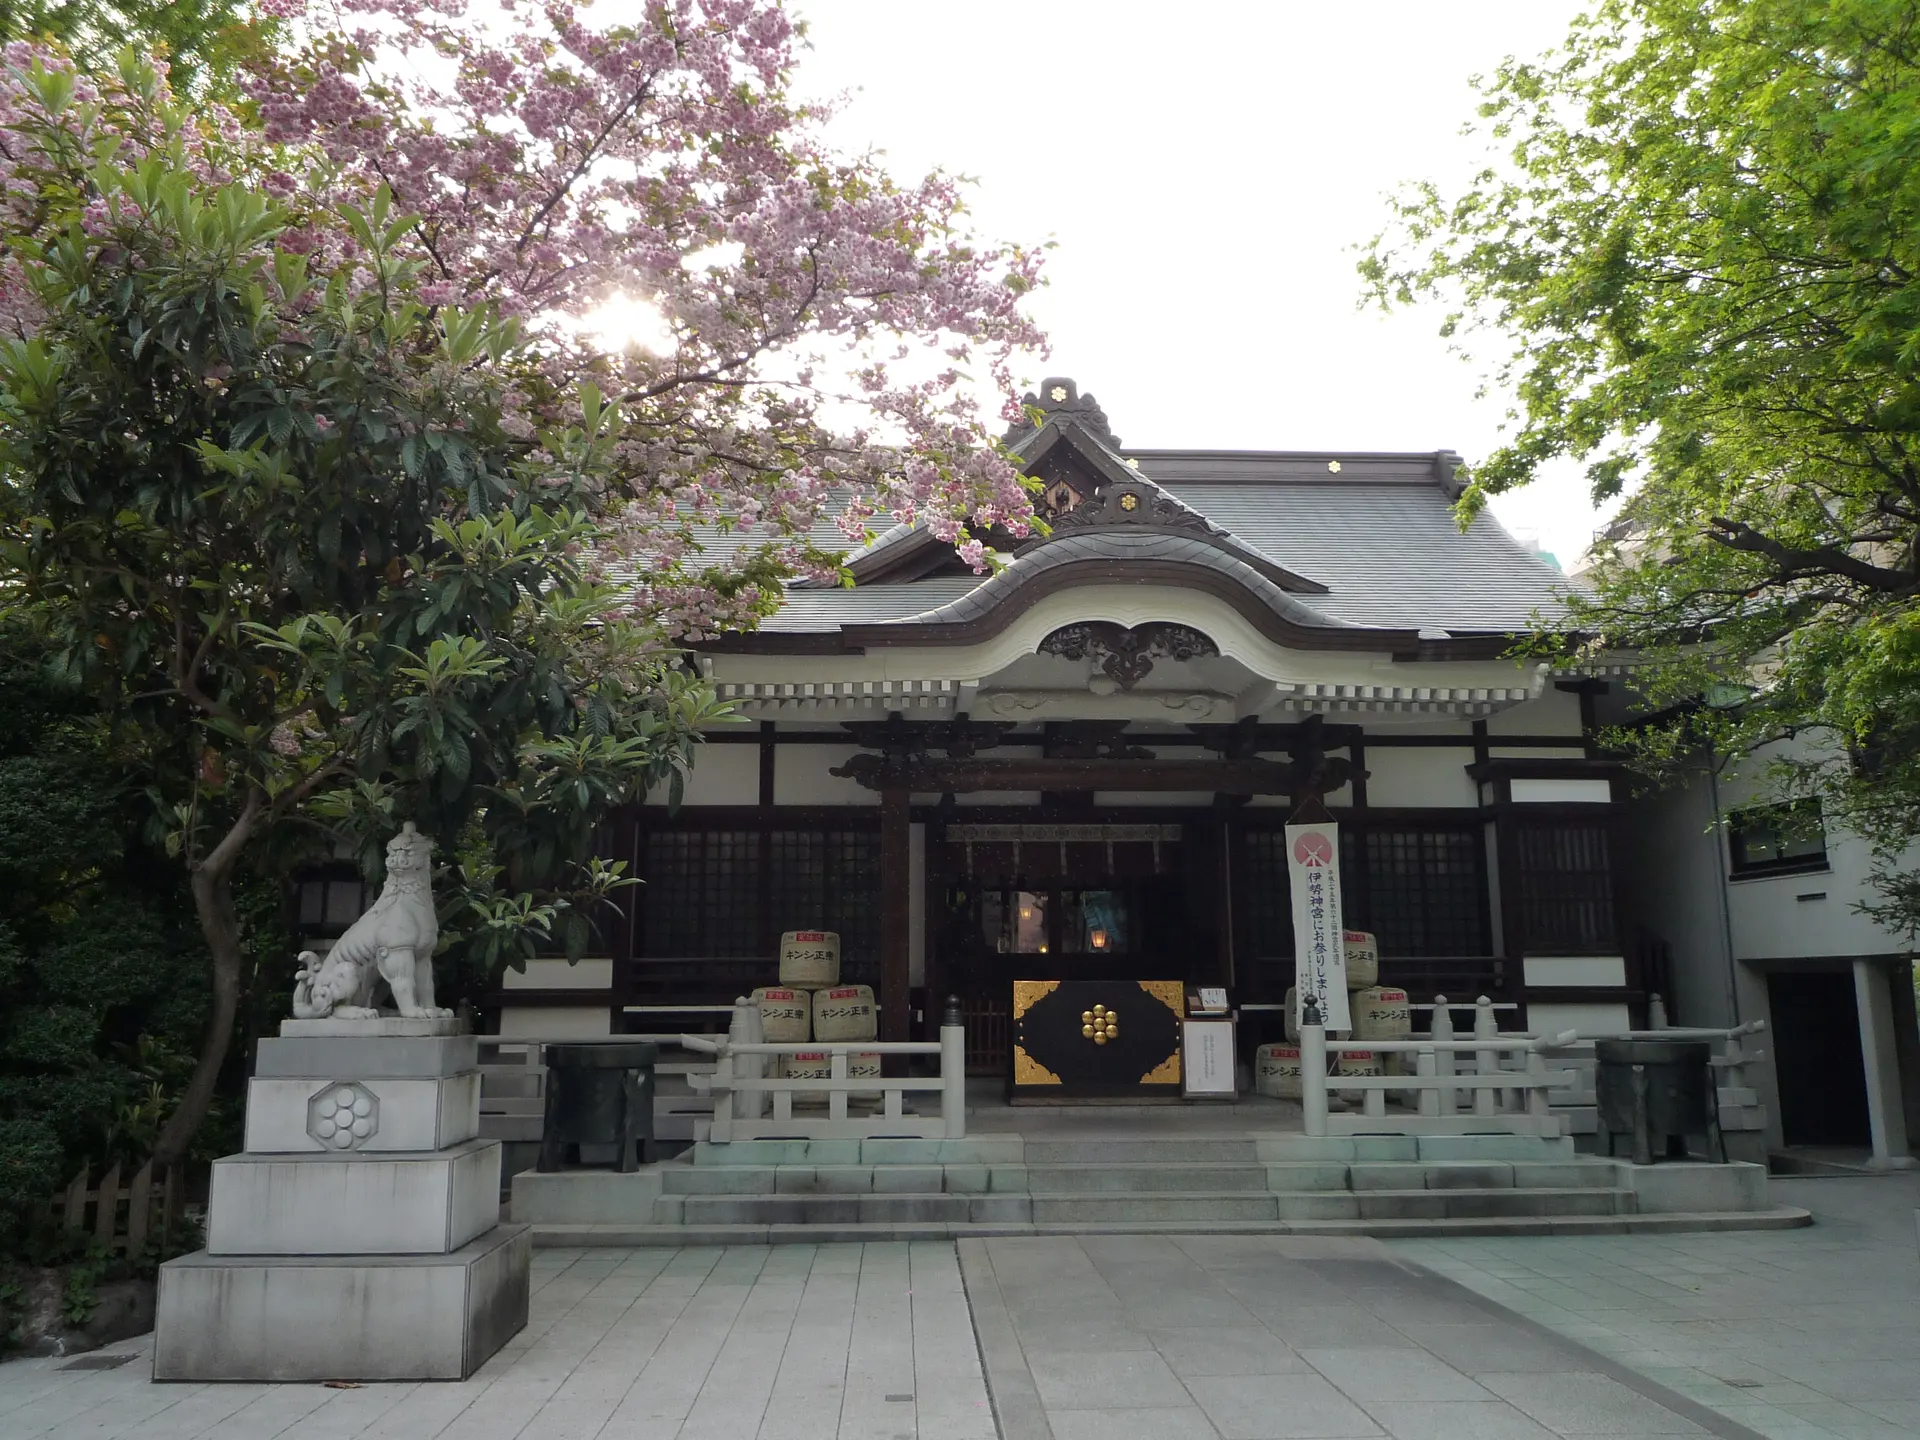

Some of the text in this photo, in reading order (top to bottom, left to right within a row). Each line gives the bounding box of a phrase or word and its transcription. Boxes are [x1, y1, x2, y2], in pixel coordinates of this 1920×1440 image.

[786, 951, 835, 961] キンシ正宗
[1344, 950, 1374, 961] シ正宗
[760, 1008, 805, 1020] ンシ正宗
[820, 1005, 870, 1020] キンシ正宗
[1261, 1066, 1301, 1077] キンシ正
